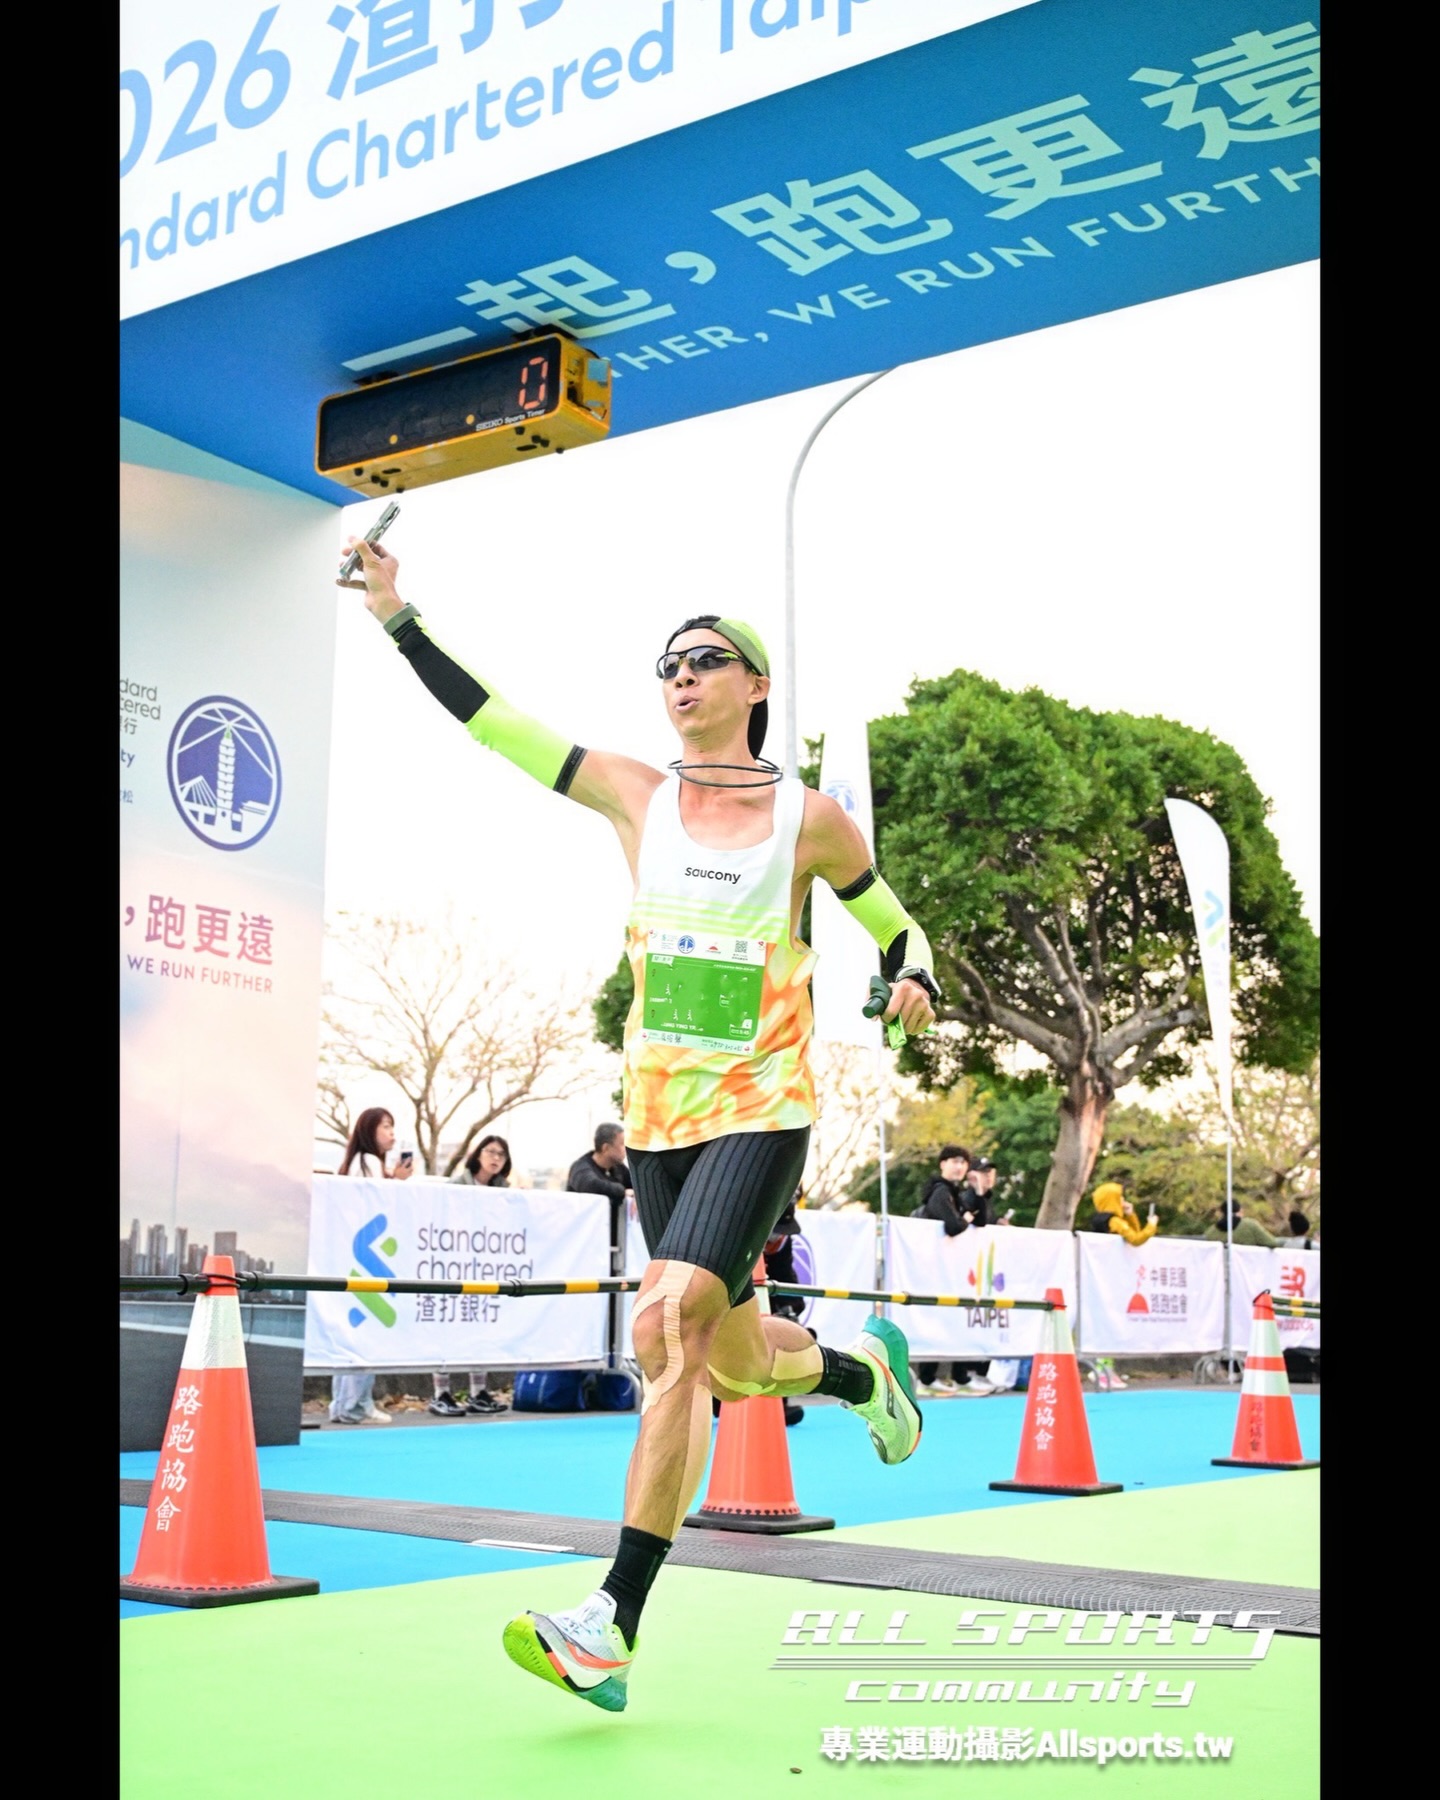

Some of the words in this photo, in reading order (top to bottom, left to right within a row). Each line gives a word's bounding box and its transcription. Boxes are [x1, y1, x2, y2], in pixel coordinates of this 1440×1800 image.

[306, 0, 675, 199] Chartered
[767, 283, 892, 325] WE
[896, 236, 1056, 294] RUN
[1067, 156, 1320, 248] FURTH
[475, 418, 503, 432] SEIKO
[504, 413, 526, 425] Sports
[526, 408, 546, 418] Timer
[684, 866, 741, 885] saucony
[127, 954, 155, 975] WE
[161, 961, 195, 980] RUN
[201, 967, 273, 995] FURTHER
[417, 1222, 527, 1255] standard
[415, 1293, 501, 1323] 渣打銀行
[964, 1305, 1010, 1329] TAIPEI
[1034, 1362, 1059, 1451] 路跑協會
[155, 1384, 203, 1533] 路跑協會
